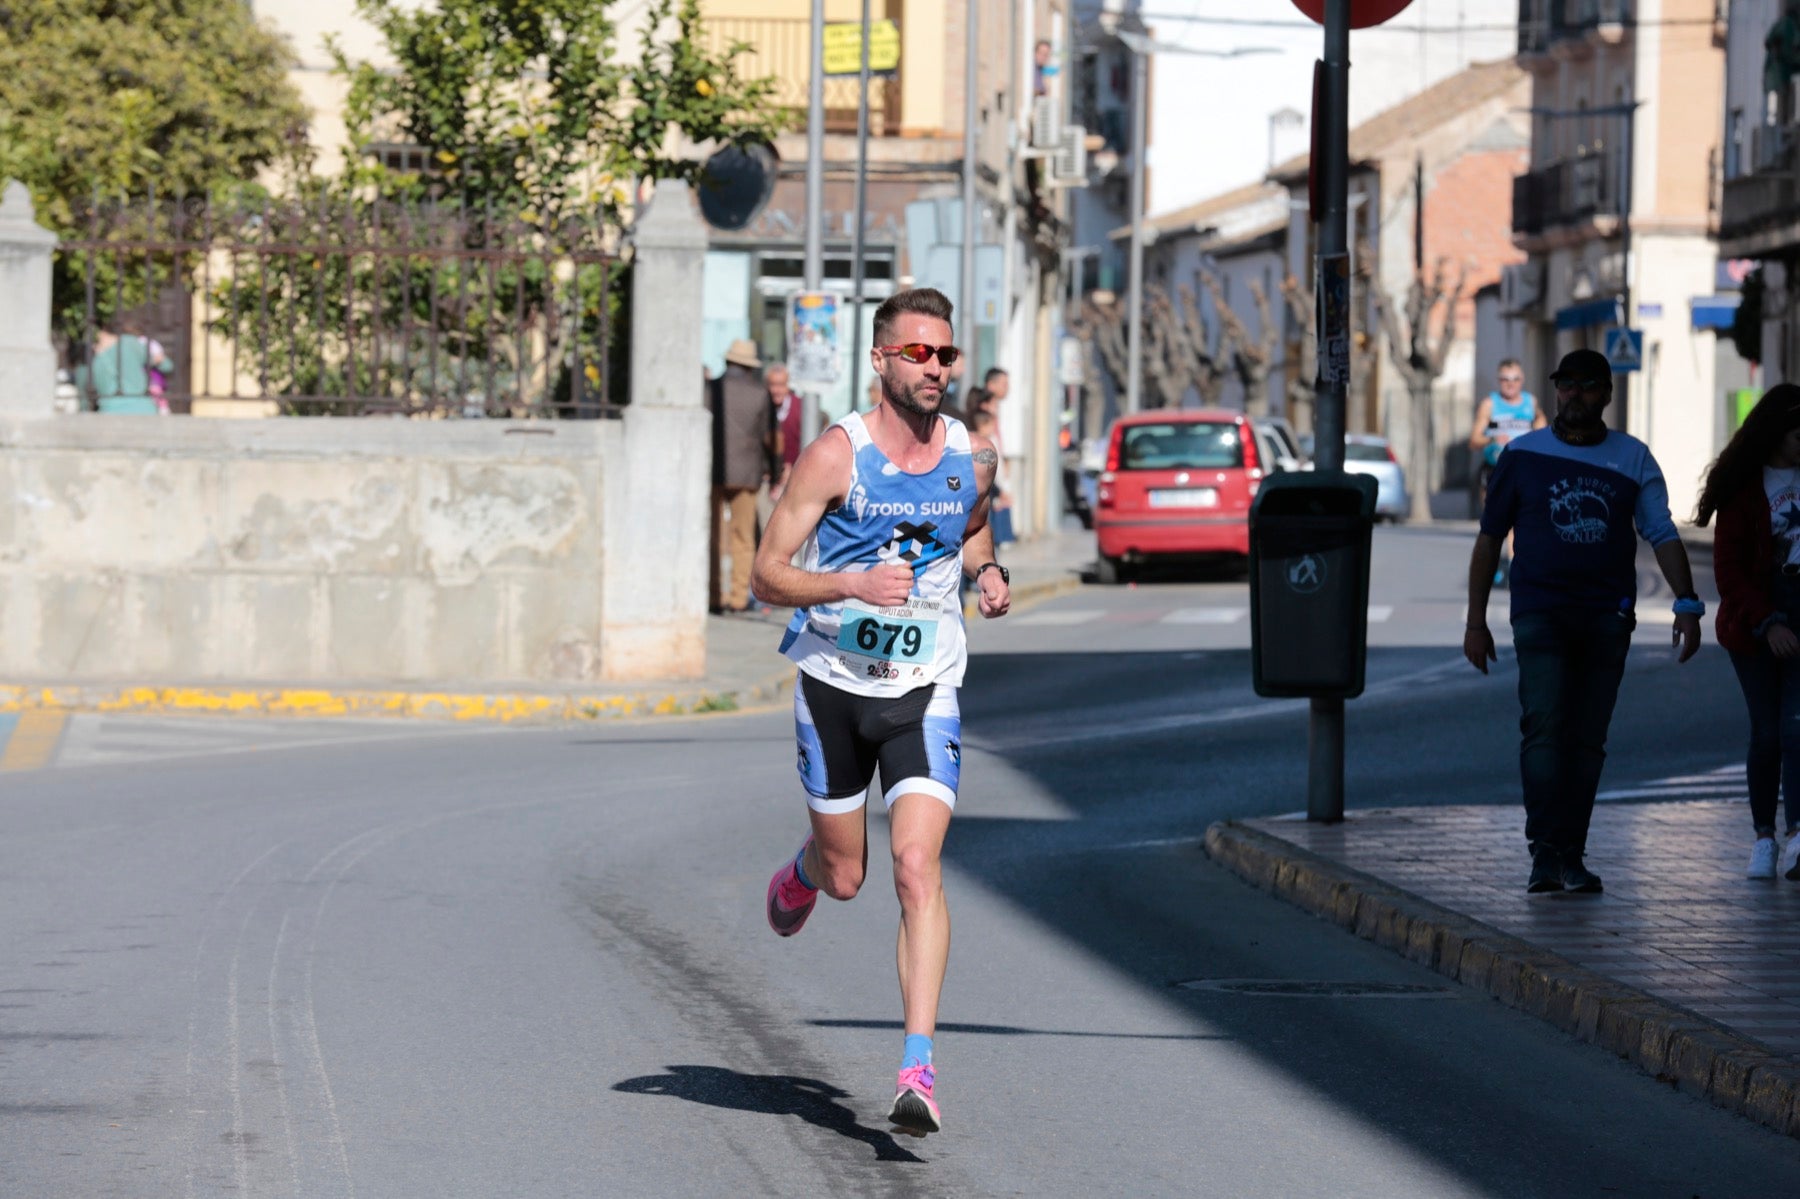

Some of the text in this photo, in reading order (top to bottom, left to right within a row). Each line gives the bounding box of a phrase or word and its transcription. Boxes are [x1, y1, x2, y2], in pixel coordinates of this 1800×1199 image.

[870, 501, 964, 517] TODO SUMA
[912, 600, 920, 609] DE
[920, 601, 940, 611] FONDO
[856, 617, 922, 657] 679
